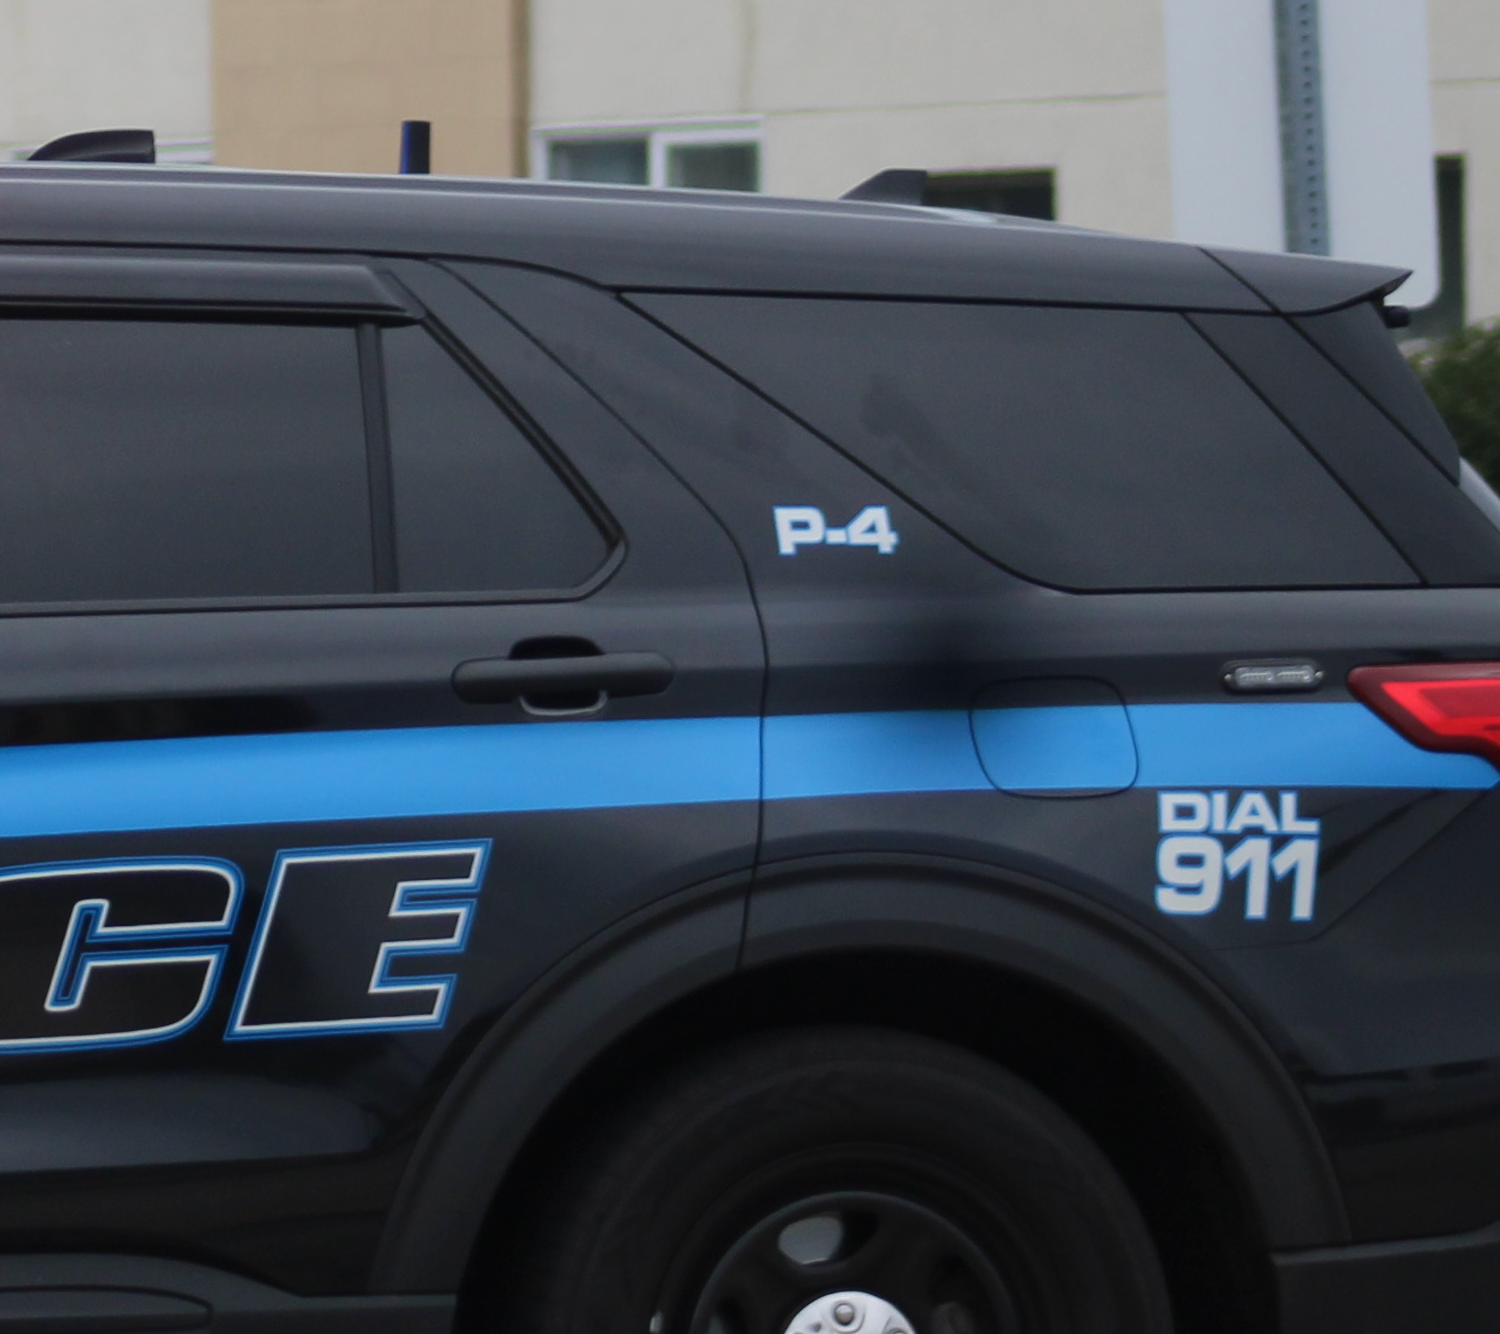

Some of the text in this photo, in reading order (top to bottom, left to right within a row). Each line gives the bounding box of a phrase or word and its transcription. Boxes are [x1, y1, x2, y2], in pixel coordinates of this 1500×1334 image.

[772, 505, 899, 555] P-4
[1156, 789, 1321, 835] DIAL
[1153, 833, 1320, 921] 911
